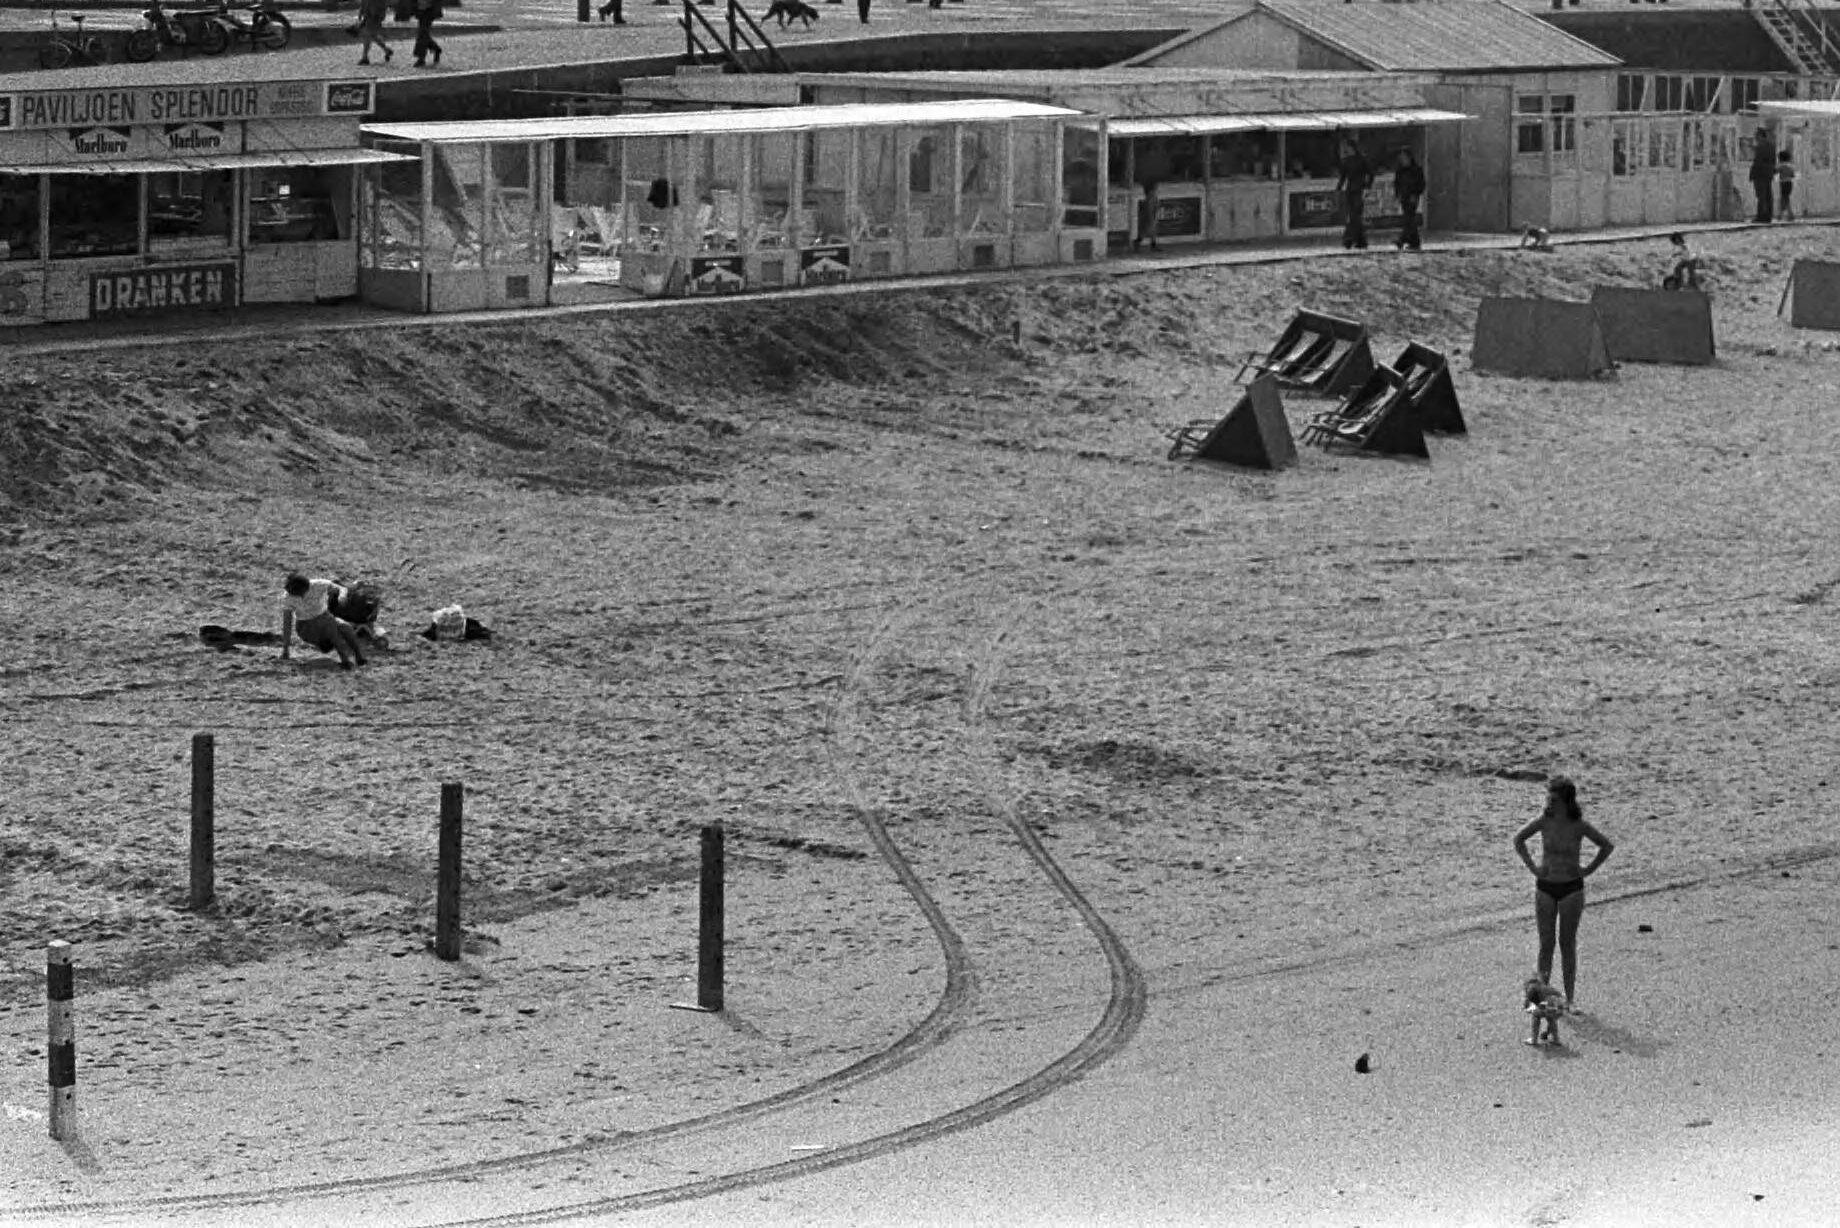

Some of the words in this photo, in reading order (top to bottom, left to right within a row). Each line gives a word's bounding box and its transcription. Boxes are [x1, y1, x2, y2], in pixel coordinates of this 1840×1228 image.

[23, 92, 135, 124] PAVILJOEN
[151, 87, 258, 120] SPLENDOR
[75, 133, 127, 154] Marlboro
[169, 129, 221, 149] Marlboro
[96, 271, 222, 311] DRANKEN
